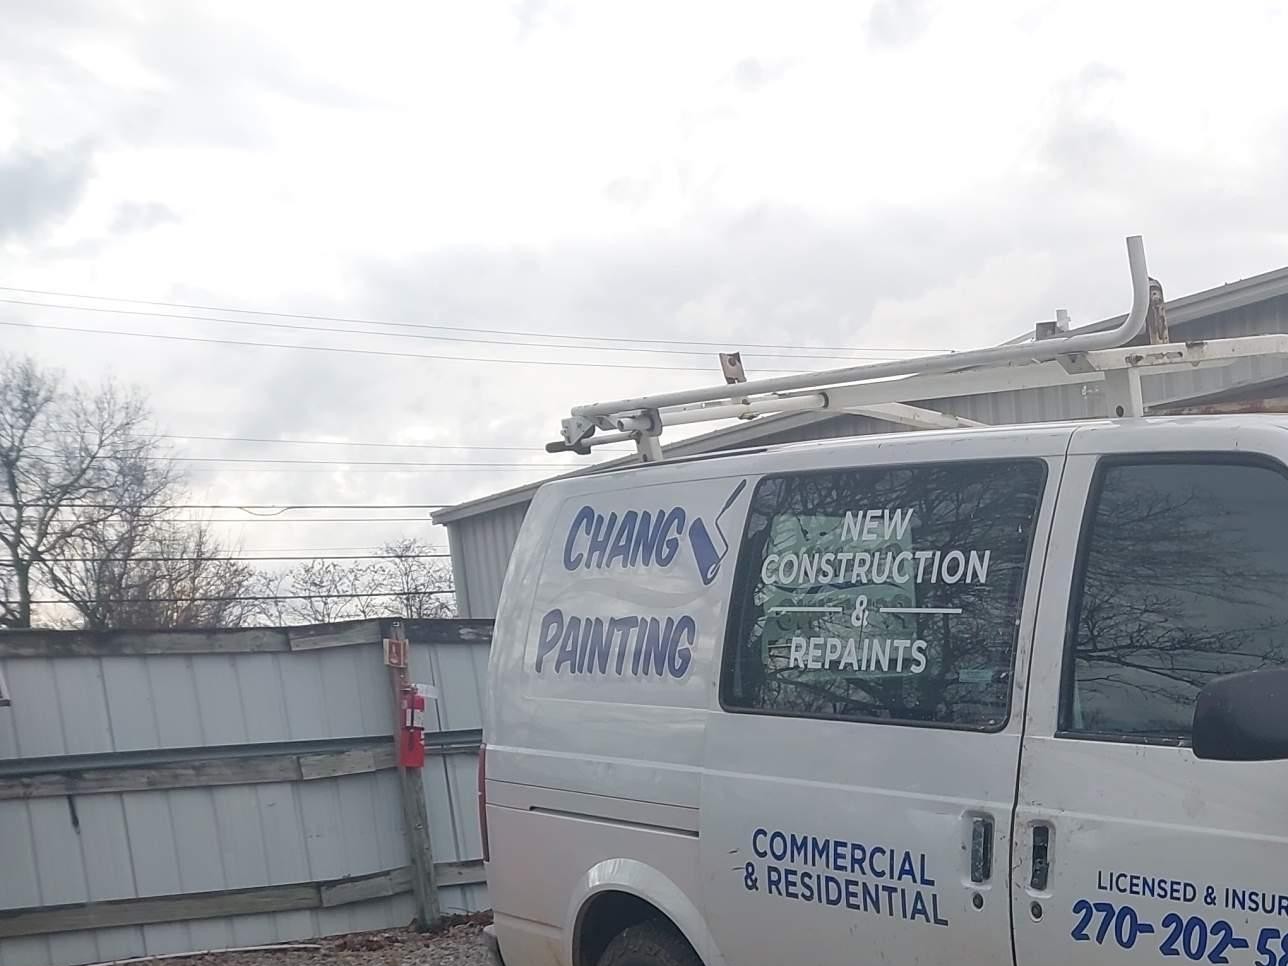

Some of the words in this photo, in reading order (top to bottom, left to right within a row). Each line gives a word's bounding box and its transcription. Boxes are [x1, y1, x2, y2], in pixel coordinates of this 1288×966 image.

[563, 505, 686, 571] CHANG
[841, 508, 914, 541] NEW
[761, 550, 991, 585] CONSTRUCTION
[851, 595, 868, 627] &
[535, 608, 696, 678] PAINTING
[788, 636, 927, 673] REPAINTS
[752, 828, 935, 886] COMMERCIAL
[744, 862, 759, 891] &
[767, 865, 949, 926] RESIDENTIAL
[1097, 870, 1197, 903] LICENSED
[1203, 885, 1217, 906] &
